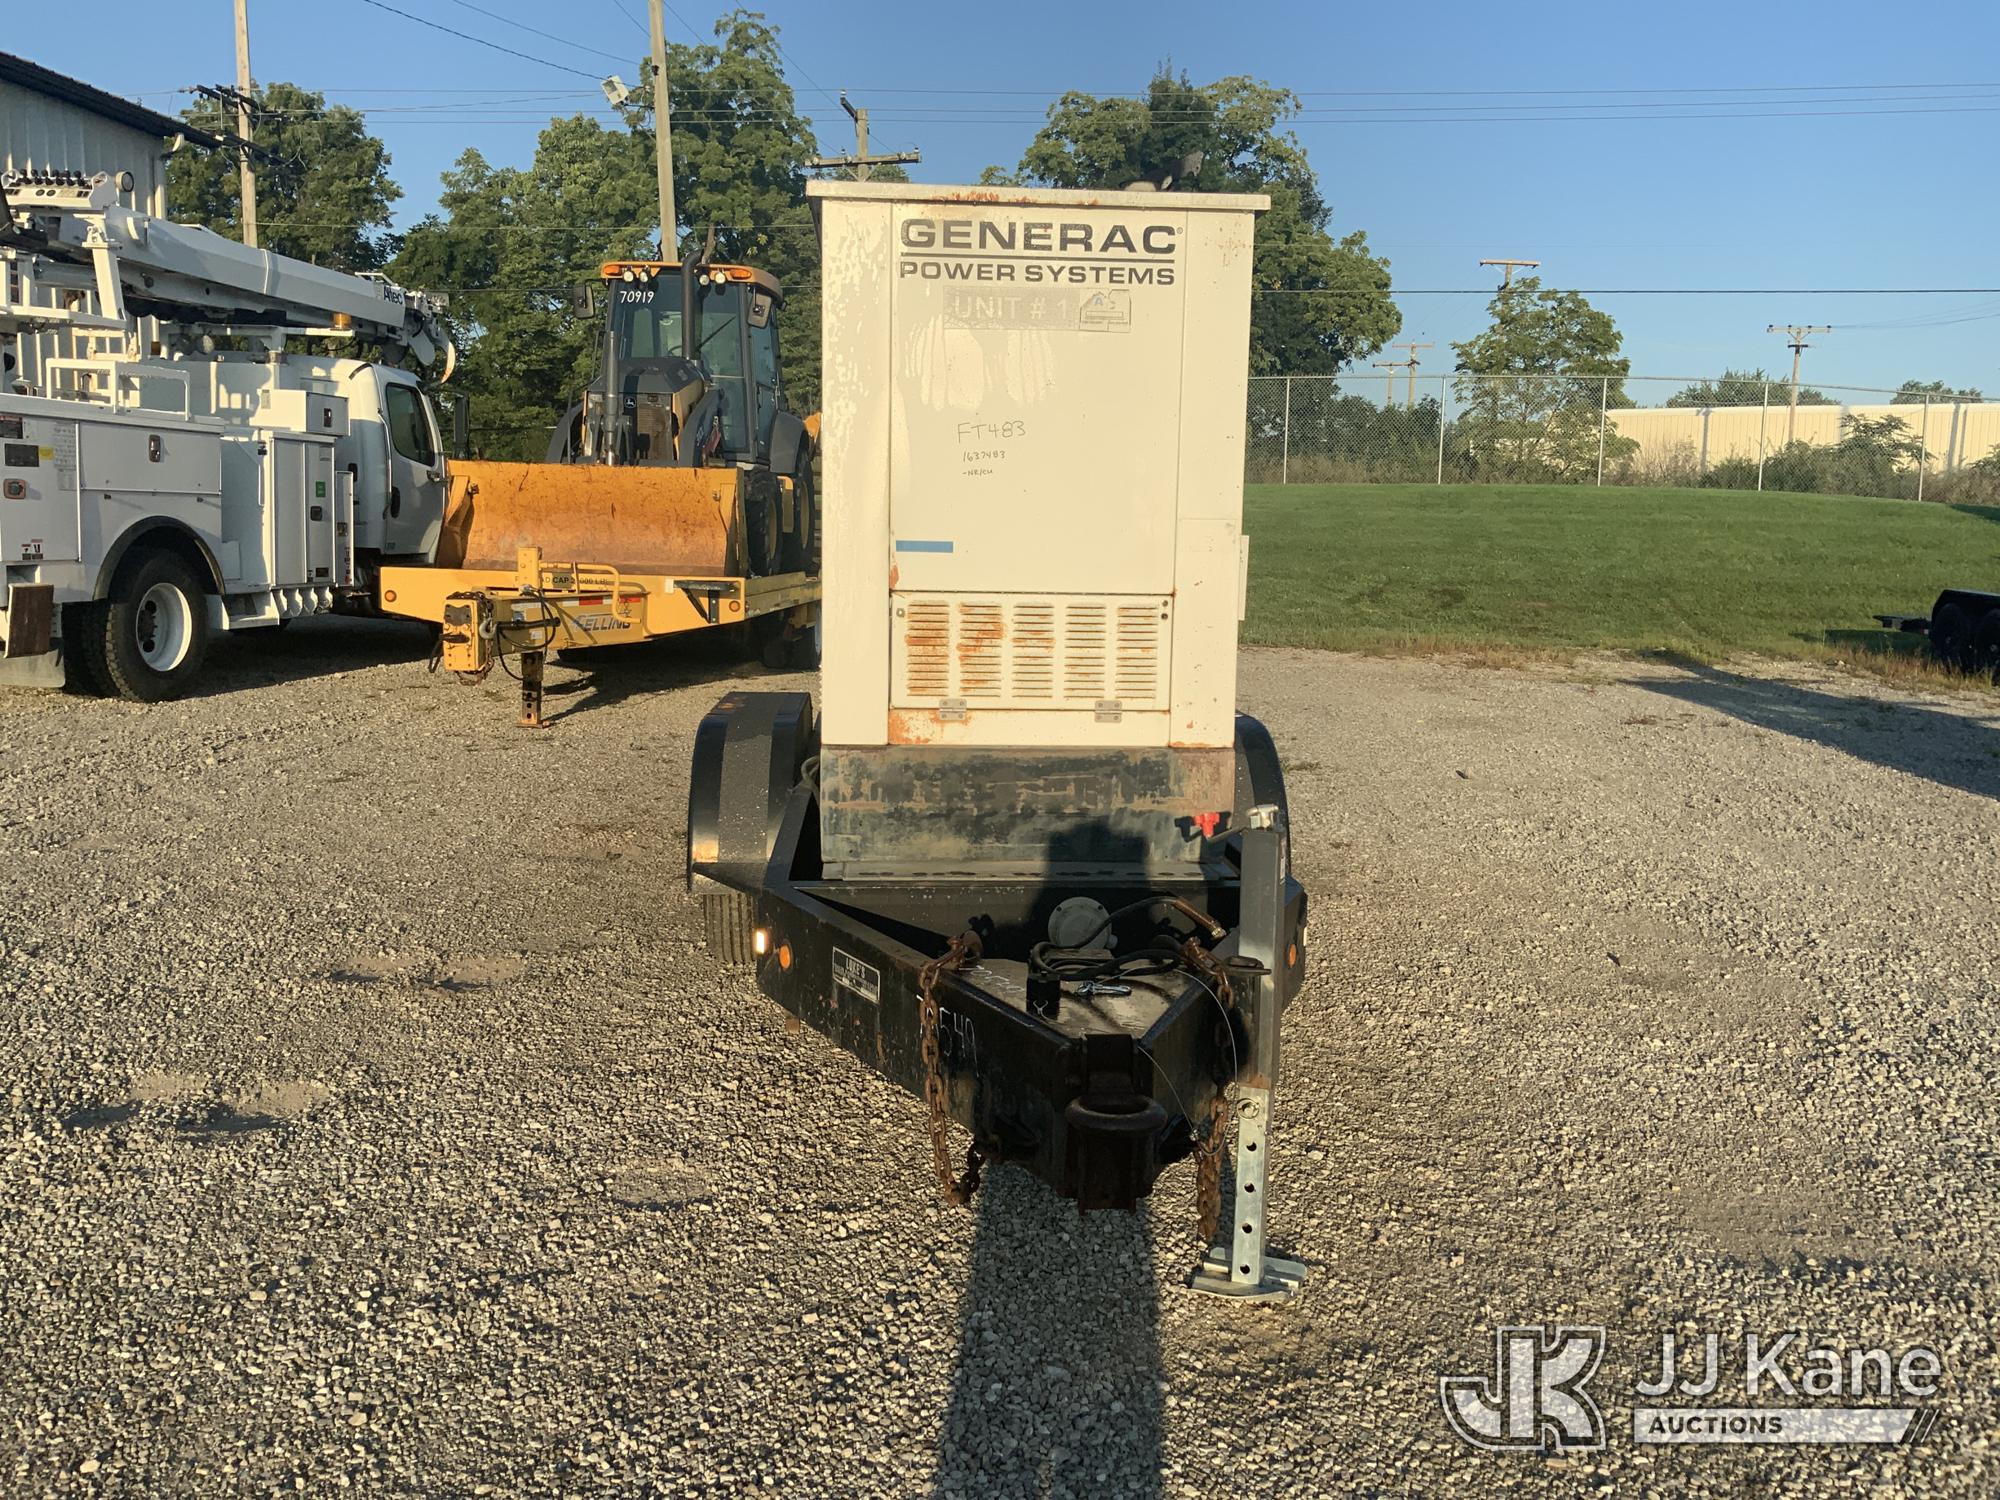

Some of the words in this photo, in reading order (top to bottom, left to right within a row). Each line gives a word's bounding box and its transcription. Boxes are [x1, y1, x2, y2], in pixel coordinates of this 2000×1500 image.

[900, 218, 1176, 255] GENERAC
[900, 261, 1016, 281] POWER
[1025, 264, 1175, 286] SYSTEMS
[620, 290, 655, 304] 70919
[953, 295, 1021, 319] UNIT
[1057, 298, 1068, 320] 1
[957, 420, 1026, 444] FT483
[552, 576, 570, 585] CAP
